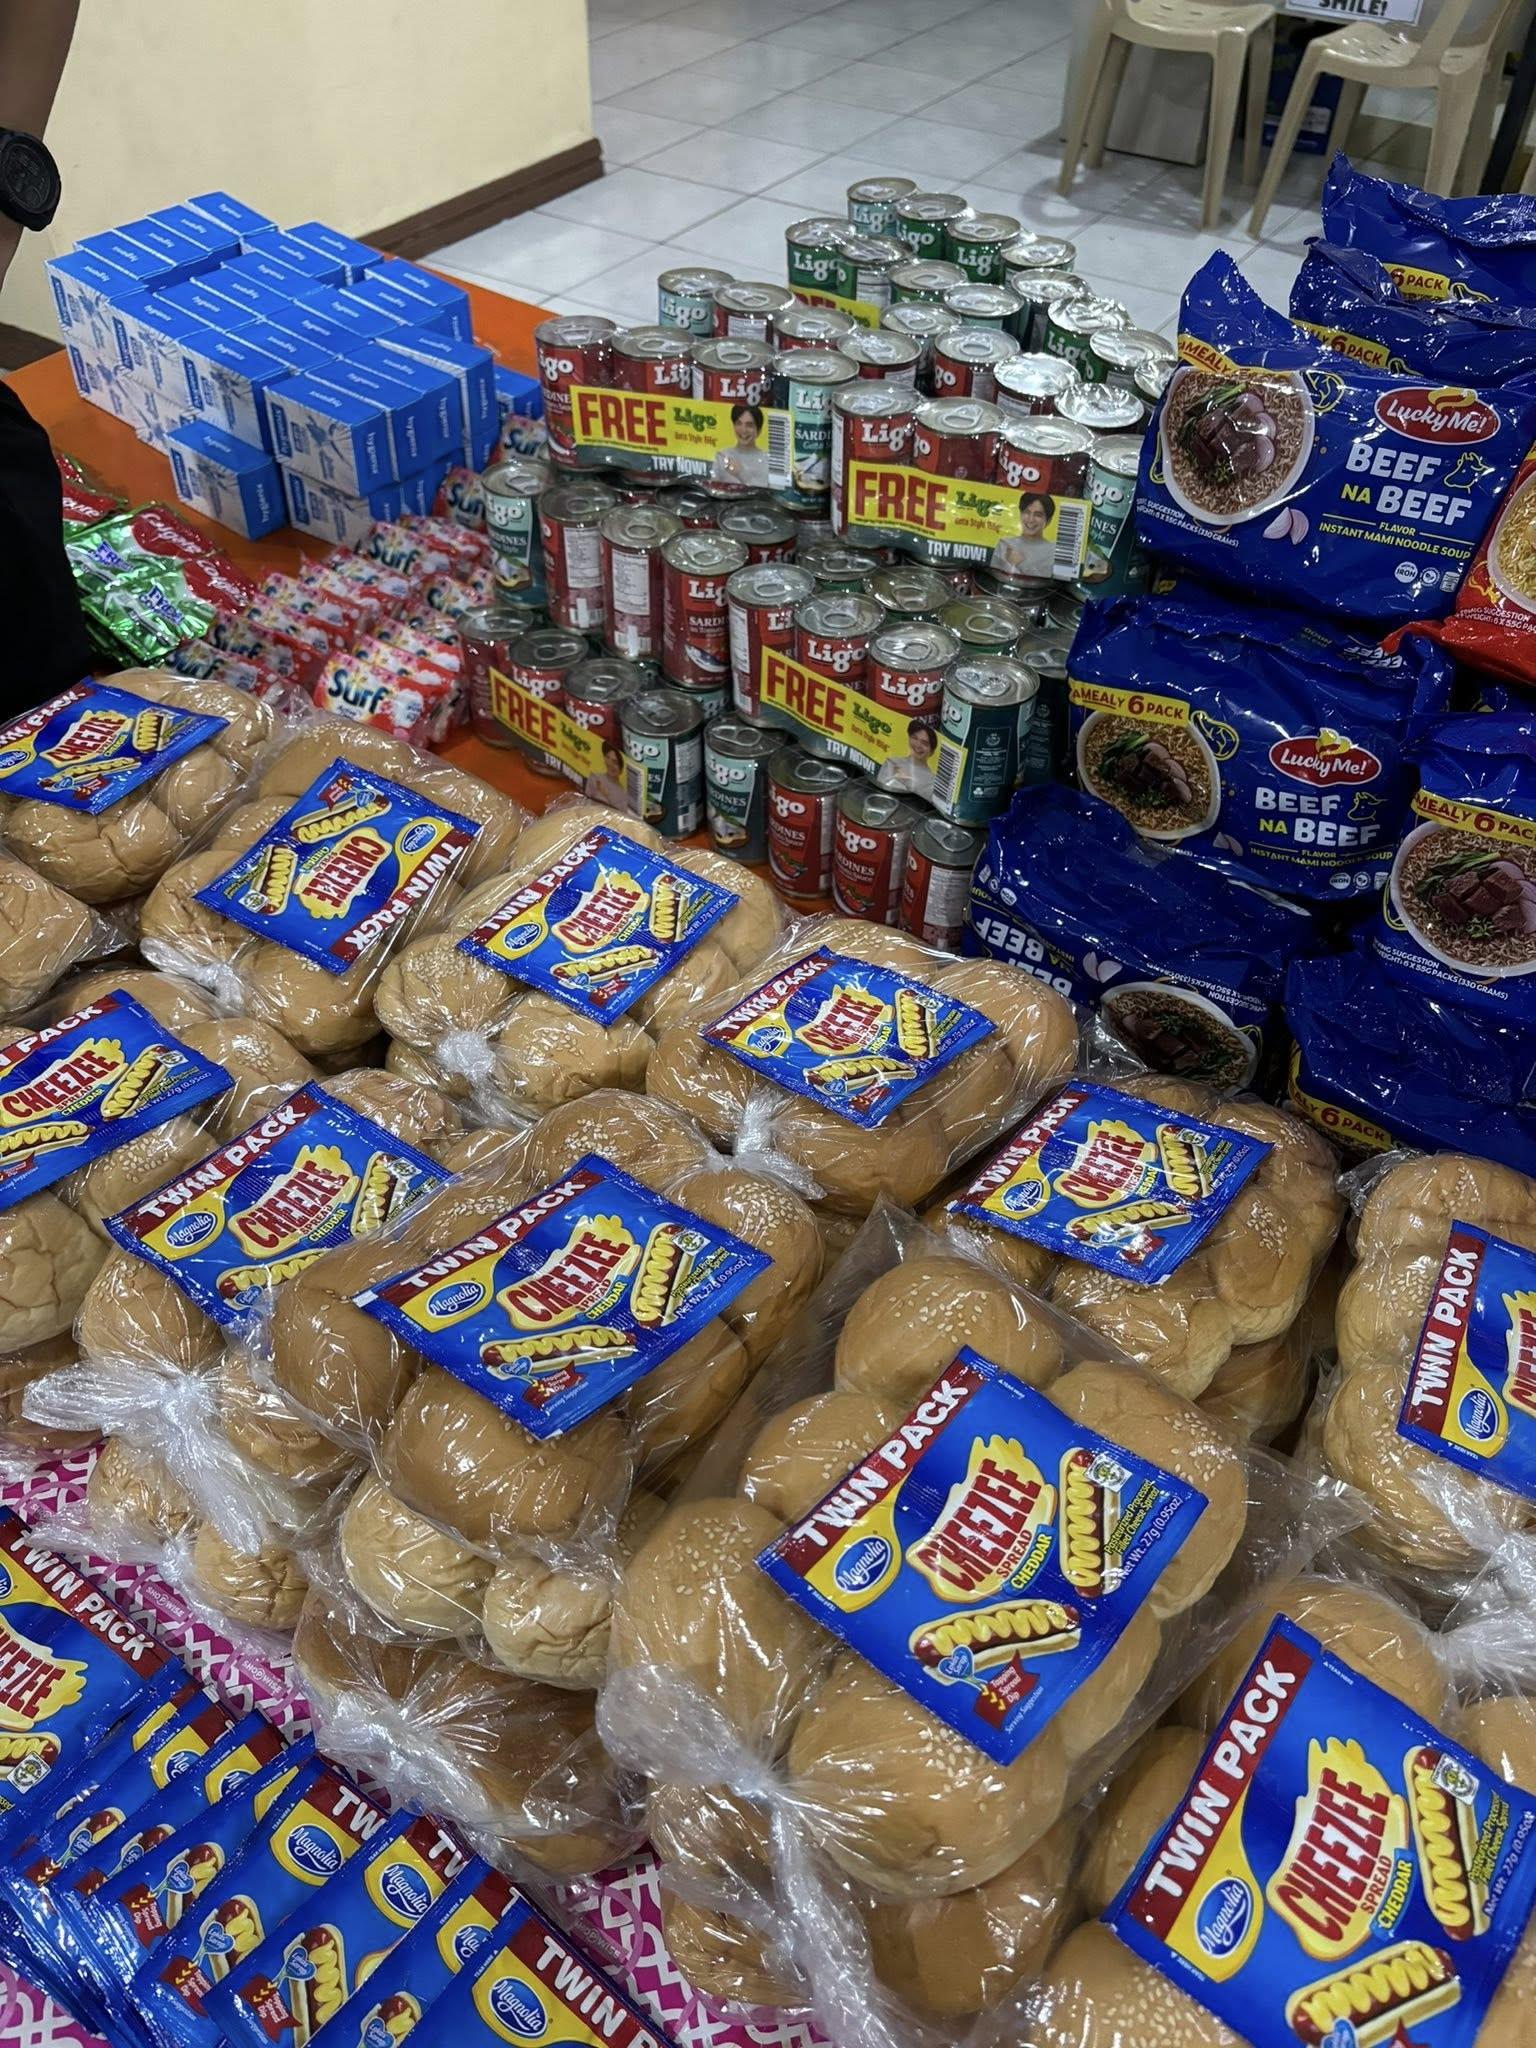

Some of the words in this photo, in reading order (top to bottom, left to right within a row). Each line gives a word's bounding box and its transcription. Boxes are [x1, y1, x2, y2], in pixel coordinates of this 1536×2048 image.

[1391, 268, 1405, 287] 6
[1407, 274, 1444, 290] PACK
[539, 350, 574, 381] igo
[1179, 341, 1231, 373] AMEALY
[1332, 335, 1347, 352] 6
[1346, 344, 1382, 365] PACK
[577, 392, 667, 446] FREE
[672, 407, 717, 432] Ligo
[1386, 401, 1450, 432] Lucky
[1448, 411, 1488, 435] Me!
[651, 456, 676, 472] TRY
[677, 457, 706, 476] NOW!
[1344, 443, 1442, 484] BEEF
[855, 470, 948, 531] FREE
[1340, 483, 1372, 505] NA
[1375, 484, 1473, 526] BEEF
[1177, 519, 1198, 533] PACKS
[1198, 526, 1212, 539] (330
[1212, 532, 1239, 548] GRAMS)
[1319, 522, 1364, 539] INSTANT
[1364, 531, 1395, 545] MAMI
[1395, 538, 1440, 555] NOODLE
[1440, 546, 1471, 560] SOUP
[1379, 521, 1416, 536] FLAVOR
[369, 534, 421, 575] Surf
[927, 540, 949, 557] TRY
[953, 543, 987, 562] NOW!
[1396, 568, 1416, 577] IRON
[1483, 606, 1530, 623] SUGGESTION
[328, 669, 390, 714] Surf
[767, 655, 847, 733] FREE
[881, 672, 942, 706] Ligo
[1128, 695, 1144, 715] 6
[1147, 703, 1183, 719] PACK
[495, 680, 557, 749] FREE
[853, 702, 893, 734] Ligo
[825, 738, 848, 757] TRY
[1280, 748, 1331, 777] Lucky
[1332, 758, 1367, 775] Me!
[1255, 787, 1341, 815] BEEF
[1473, 812, 1497, 833] 6
[1259, 819, 1288, 834] NA
[1294, 817, 1380, 847] BEEF
[1301, 850, 1336, 858] FLAVOR
[302, 836, 385, 907] CHEEZEE
[402, 843, 463, 900] TWIN
[1250, 848, 1290, 861] INSTANT
[1291, 856, 1319, 866] MAMI
[479, 890, 542, 931] TWIN
[537, 836, 600, 887] PACK
[345, 899, 409, 950] PACK
[558, 882, 642, 947] CHEEZEE
[975, 917, 1044, 963] BEEF
[1392, 948, 1440, 970] SUGGESTION
[1402, 959, 1410, 967] 6
[1409, 961, 1416, 969] X
[1415, 963, 1433, 975] 55G
[1432, 967, 1459, 984] PACKS
[1458, 974, 1477, 990] (330
[1476, 982, 1509, 1001] GRAMS)
[19, 1006, 103, 1053] PACK
[2, 1050, 120, 1118] CHEEZEE
[61, 1088, 105, 1117] CHEDDAR
[969, 1144, 1031, 1195] TWIN
[1021, 1097, 1079, 1144] PACK
[1321, 1107, 1340, 1126] 6
[1342, 1118, 1384, 1141] PACK
[138, 1160, 228, 1219] TWIN
[228, 1104, 308, 1167] PACK
[237, 1160, 349, 1249] CHEEZEE
[307, 1207, 348, 1243] CHEDDAR
[167, 1211, 216, 1248] Magnolia
[400, 1235, 499, 1290] TWIN
[495, 1179, 587, 1241] PACK
[427, 1281, 483, 1317] Magnolia
[506, 1231, 631, 1323] CHEEZEE
[1432, 1246, 1478, 1328] PACK
[584, 1279, 628, 1322] CHEDDAR
[1411, 1330, 1457, 1408] TWIN
[1464, 1391, 1488, 1440] Magnolia
[792, 1468, 889, 1549] TWIN
[883, 1378, 970, 1469] PACK
[921, 1457, 1042, 1592] CHEEZEE
[1129, 1545, 1147, 1564] Wt.
[1141, 1529, 1161, 1548] 27g
[1153, 1496, 1183, 1531] (0.95oz)
[835, 1535, 888, 1592] Magnolia
[999, 1529, 1034, 1580] SPREAD
[1010, 1532, 1053, 1591] CHEDDAR
[10, 1529, 84, 1600] TWIN
[75, 1592, 155, 1661] PACK
[146, 1586, 186, 1618] SHOPWISE
[241, 1660, 283, 1695] SHOPWISE
[1006, 1691, 1020, 1703] Dip
[1144, 1779, 1232, 1898] TWIN
[1214, 1660, 1296, 1780] PACK
[290, 1824, 339, 1871] Magnolia
[1275, 1766, 1390, 1942] CHEEZEE
[386, 1864, 428, 1914] Magnolia
[1360, 1854, 1392, 1914] SPREAD
[1379, 1859, 1414, 1931] CHEDDAR
[1200, 1882, 1246, 1956] Magnolia
[493, 1979, 546, 2032] Magnolia
[535, 1935, 627, 2038] TWIN
